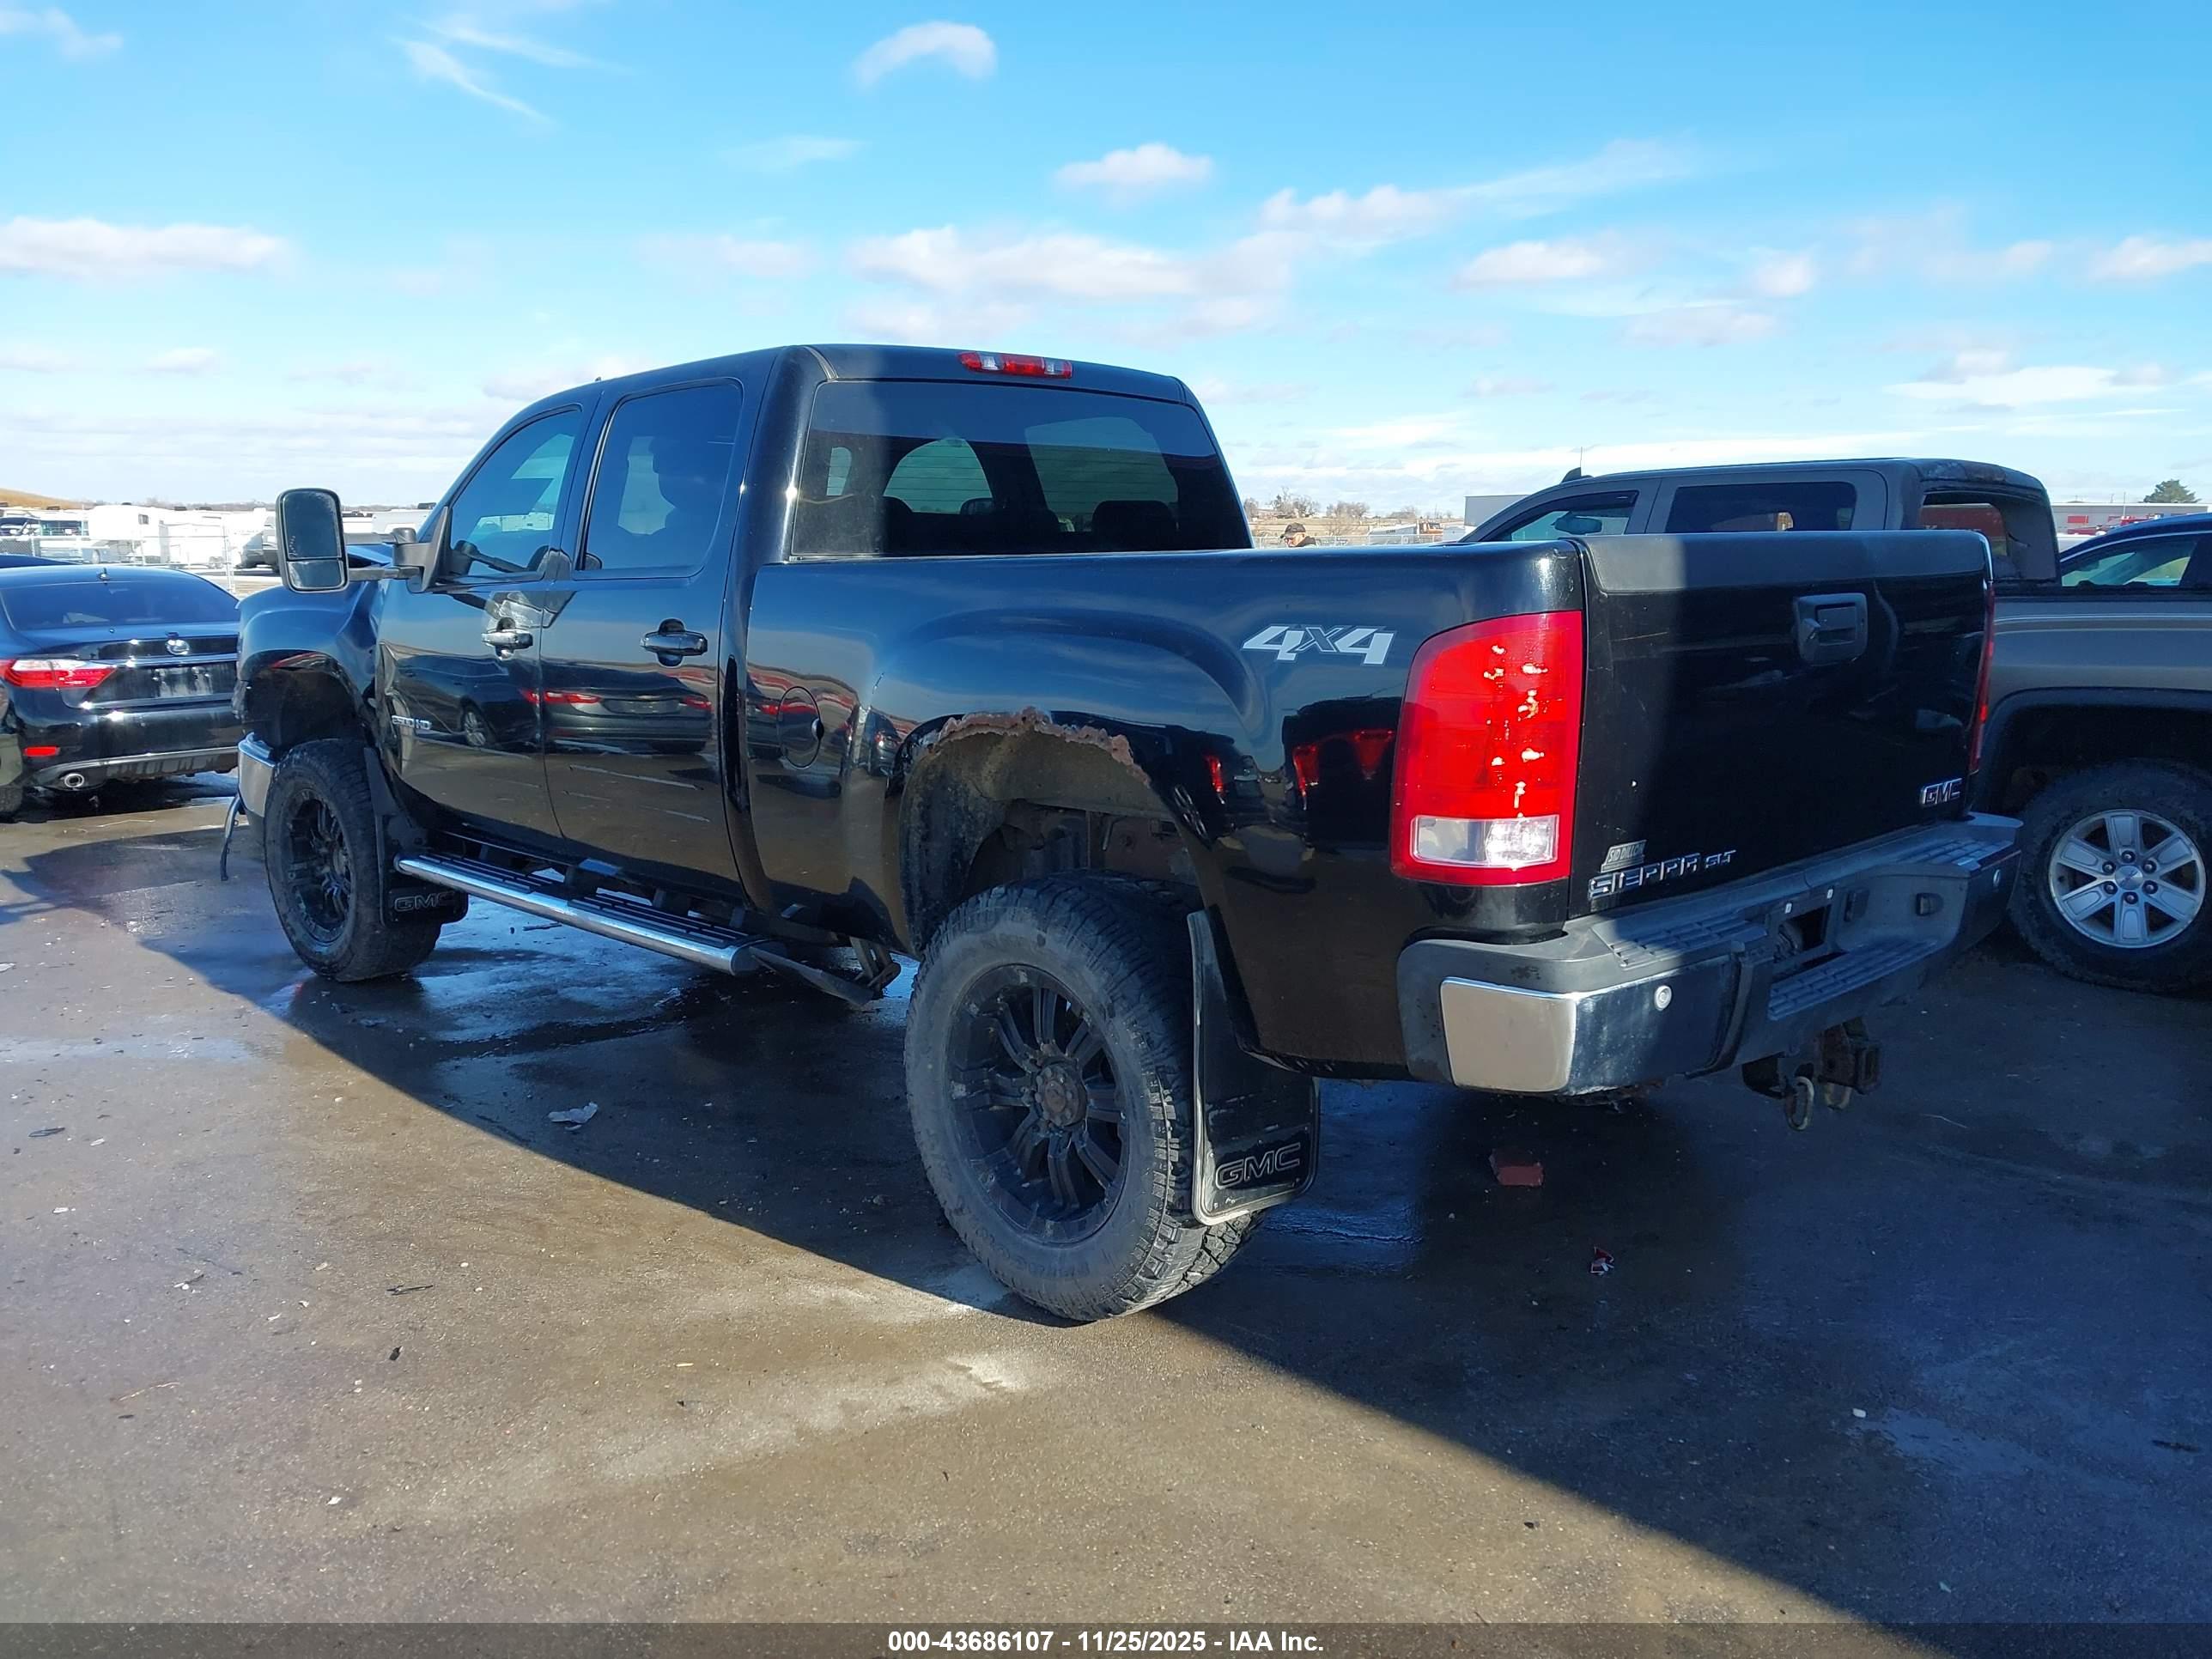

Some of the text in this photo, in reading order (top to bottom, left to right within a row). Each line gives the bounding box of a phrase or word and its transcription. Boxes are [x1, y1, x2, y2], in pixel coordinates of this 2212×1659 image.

[1921, 777, 1963, 806] GMC
[1589, 849, 1736, 900] SIERRA SLT
[394, 890, 455, 912] GMC
[1215, 1142, 1301, 1189] GMC
